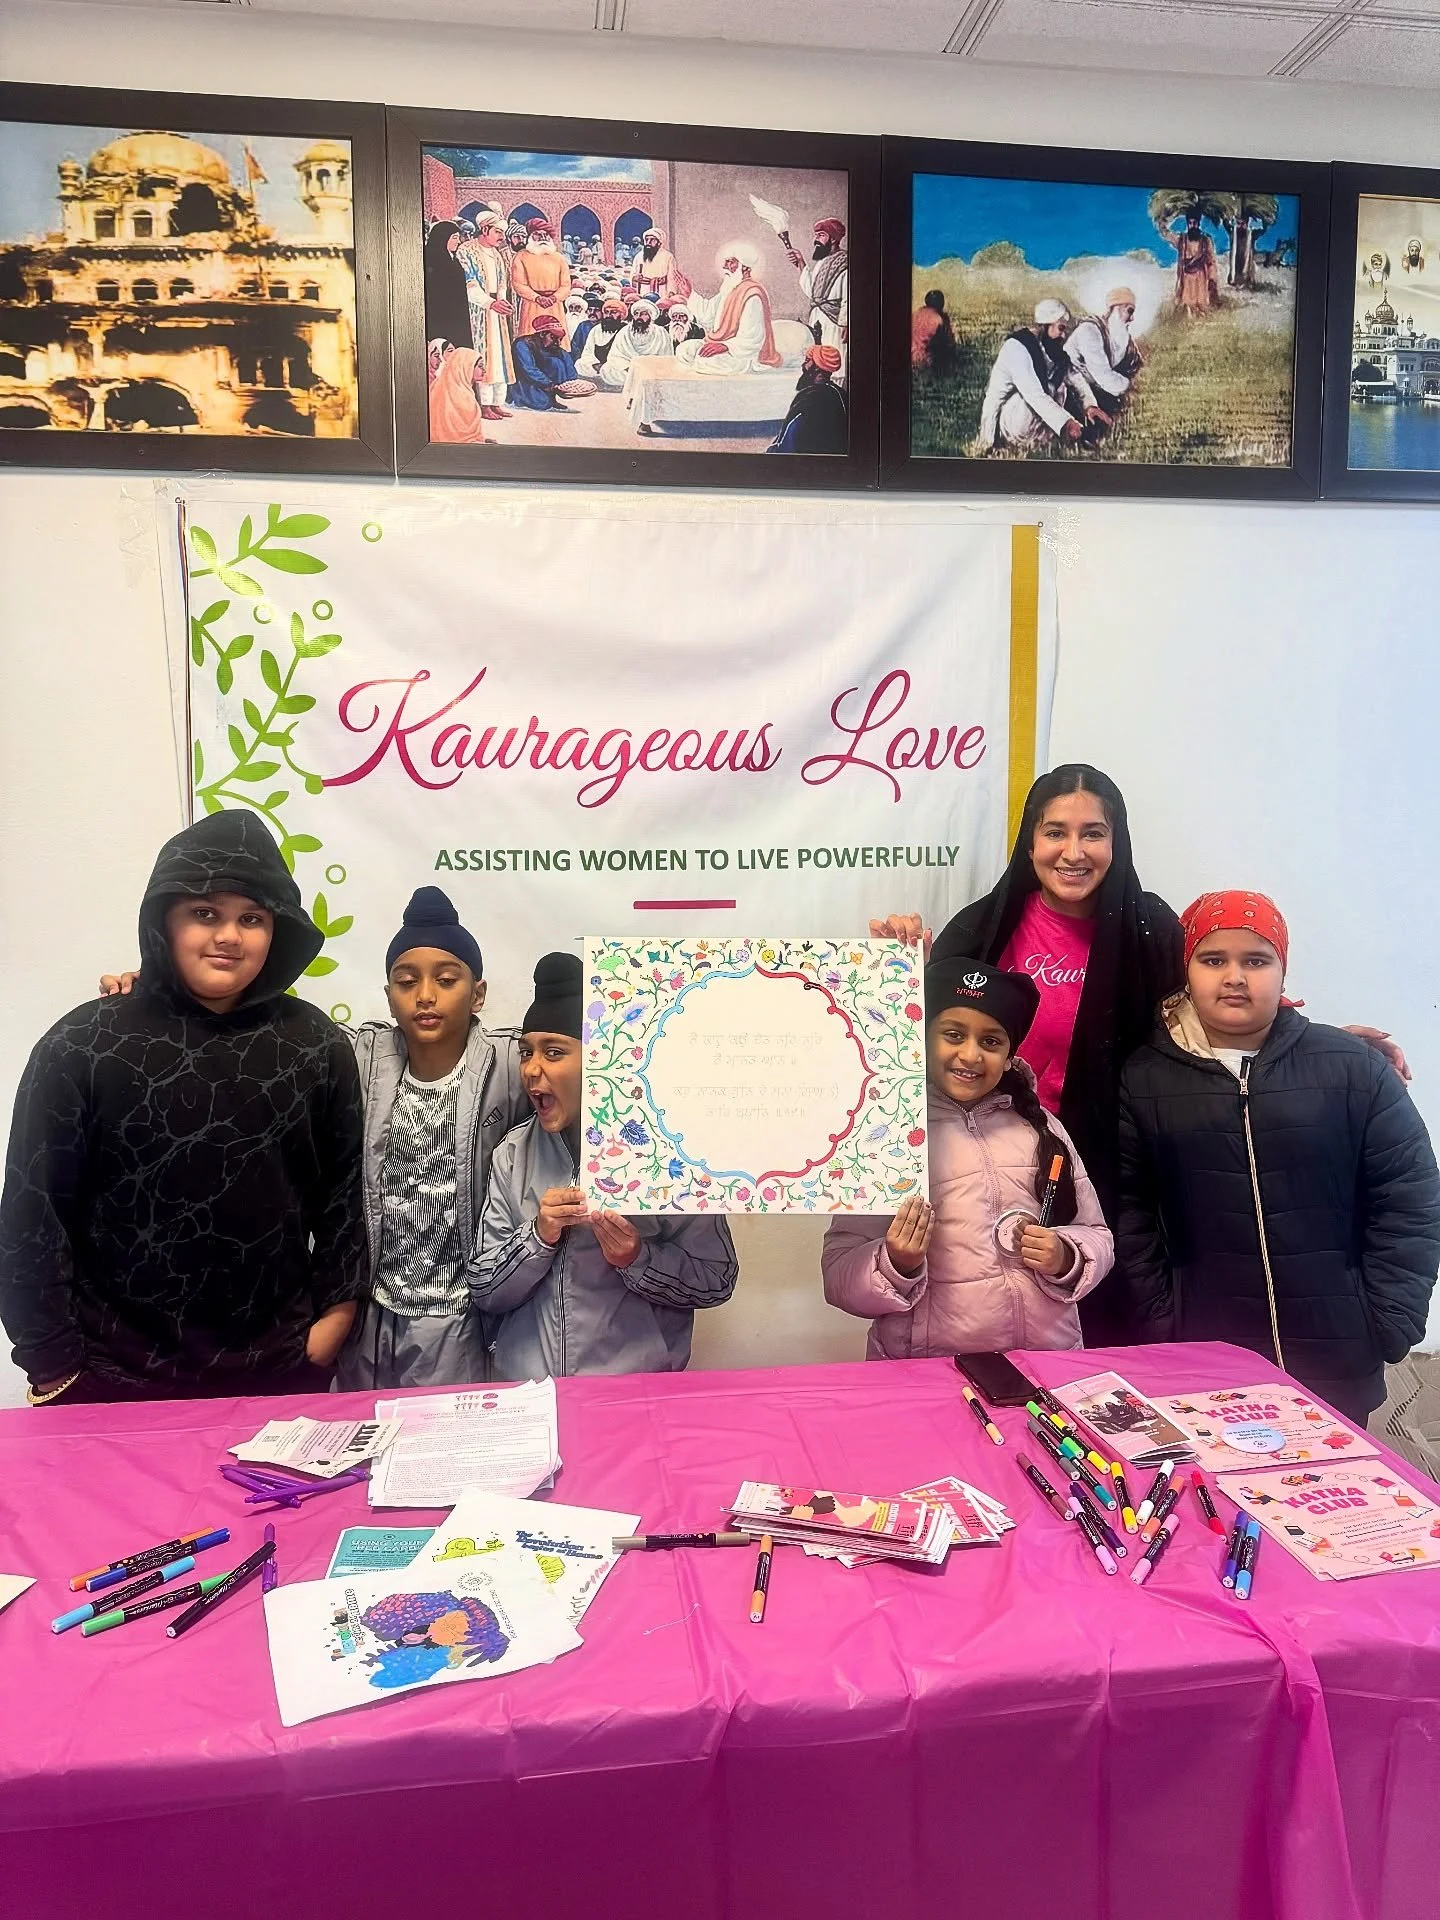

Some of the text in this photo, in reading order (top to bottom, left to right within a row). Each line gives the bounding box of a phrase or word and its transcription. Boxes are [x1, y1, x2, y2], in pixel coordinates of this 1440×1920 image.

[322, 666, 987, 808] Kaurageous Love
[434, 845, 960, 872] ASSISTING WOMEN TO LIVE POWERFULLY
[1206, 1403, 1281, 1418] KATHA
[1222, 1411, 1280, 1424] CLUB
[1284, 1486, 1368, 1508] KATHA
[1307, 1497, 1369, 1515] CLUB
